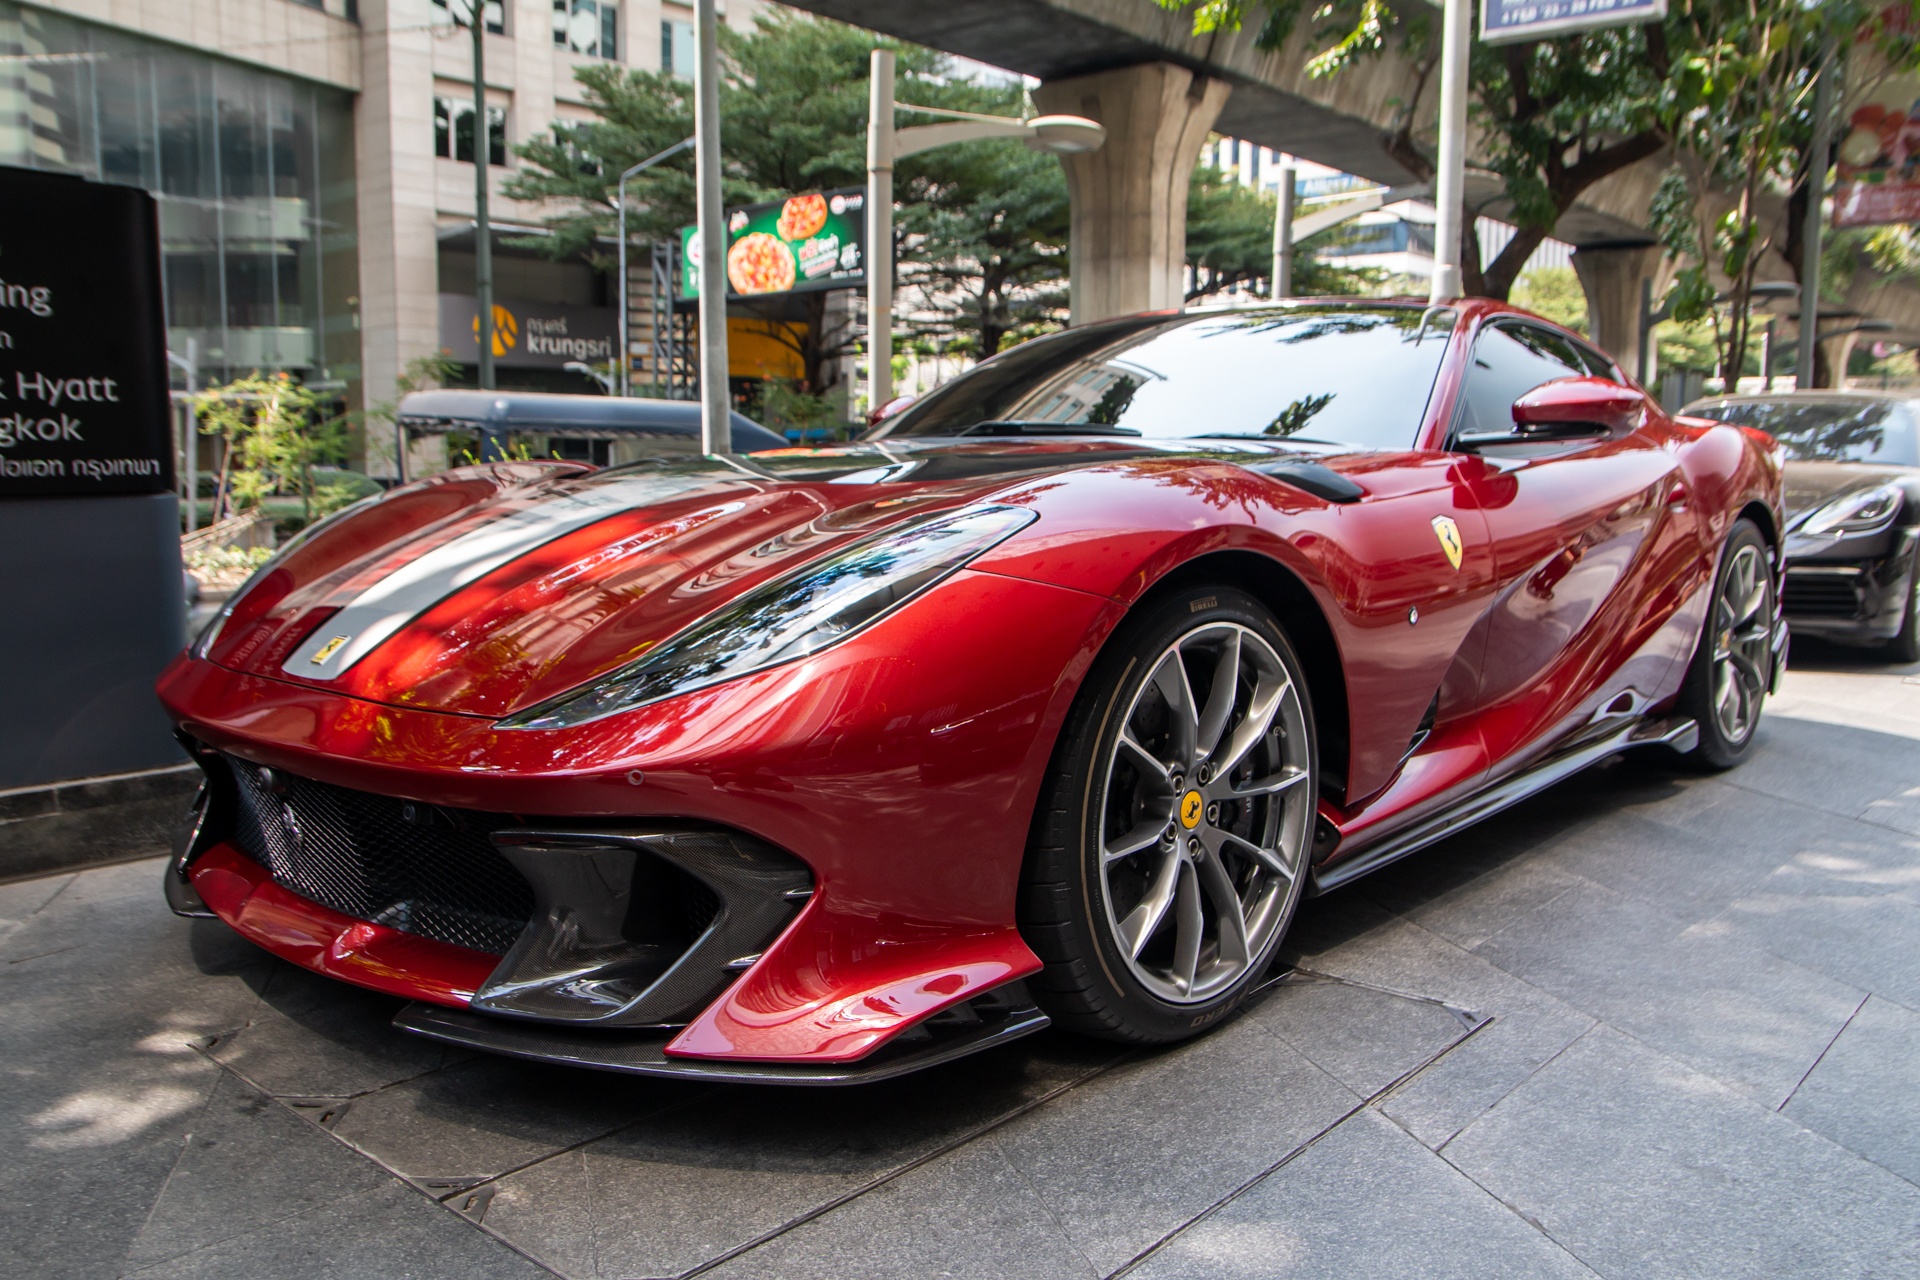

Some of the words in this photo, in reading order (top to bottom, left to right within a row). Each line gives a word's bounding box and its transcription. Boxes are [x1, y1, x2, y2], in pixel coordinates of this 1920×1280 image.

[527, 331, 612, 361] krungsri
[16, 371, 120, 407] Hyatt
[0, 412, 85, 448] gkok
[1190, 596, 1218, 613] PIRELLI
